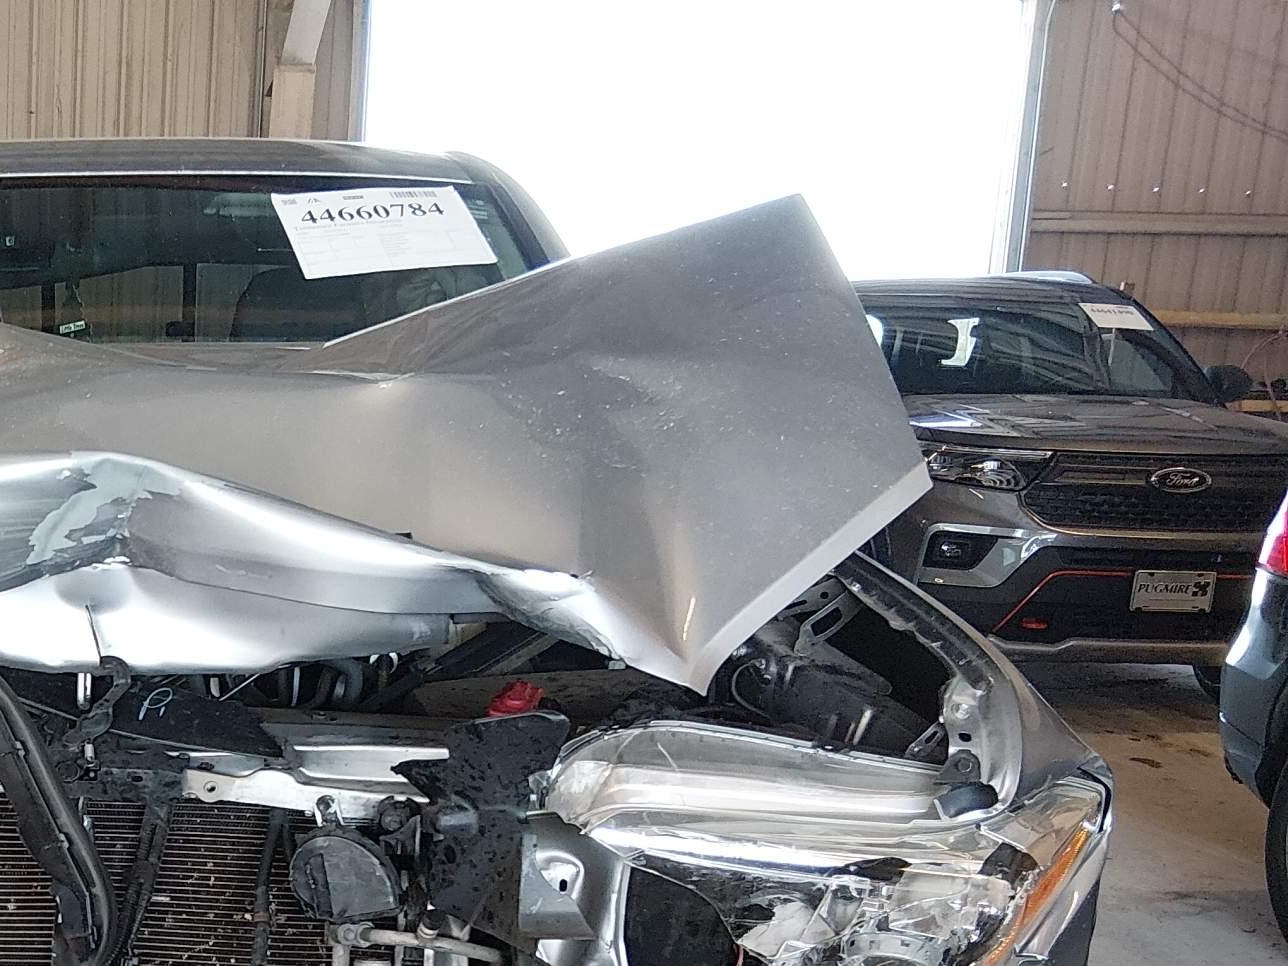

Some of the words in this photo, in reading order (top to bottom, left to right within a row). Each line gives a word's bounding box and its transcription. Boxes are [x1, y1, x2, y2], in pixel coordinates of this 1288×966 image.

[302, 201, 445, 225] 44660784
[1165, 472, 1200, 486] Ford
[1137, 583, 1192, 594] PUGMIRE
